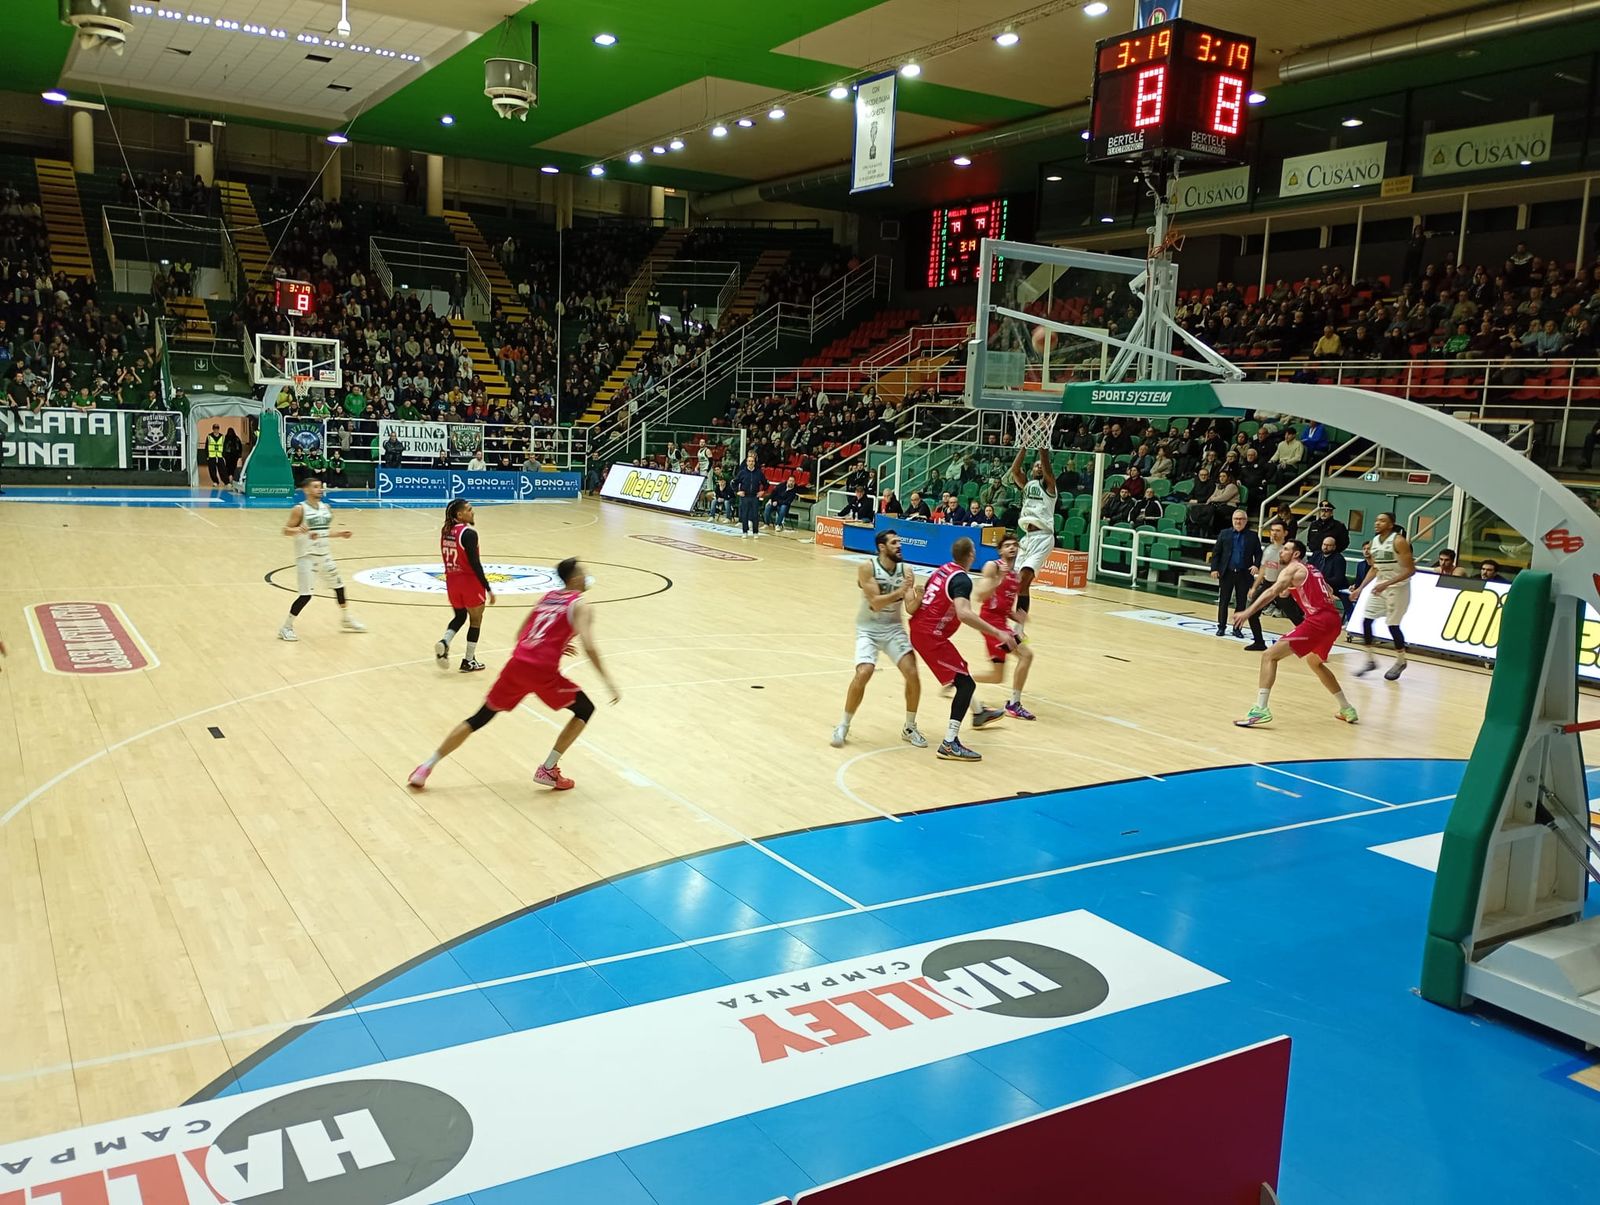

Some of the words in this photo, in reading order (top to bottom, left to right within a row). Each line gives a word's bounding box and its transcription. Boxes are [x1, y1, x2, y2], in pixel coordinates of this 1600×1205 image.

[1117, 29, 1171, 69] 3:19
[1198, 34, 1250, 70] 3:19
[1135, 67, 1164, 127] 8
[1213, 76, 1243, 134] 8
[960, 240, 976, 253] 3:19
[951, 269, 957, 280] 4
[289, 283, 311, 294] 3:19
[297, 294, 309, 311] 8
[395, 476, 429, 485] BONO
[467, 478, 499, 486] BONO
[717, 961, 911, 1009] CAMPANIA
[738, 956, 1063, 1064] HALLEY
